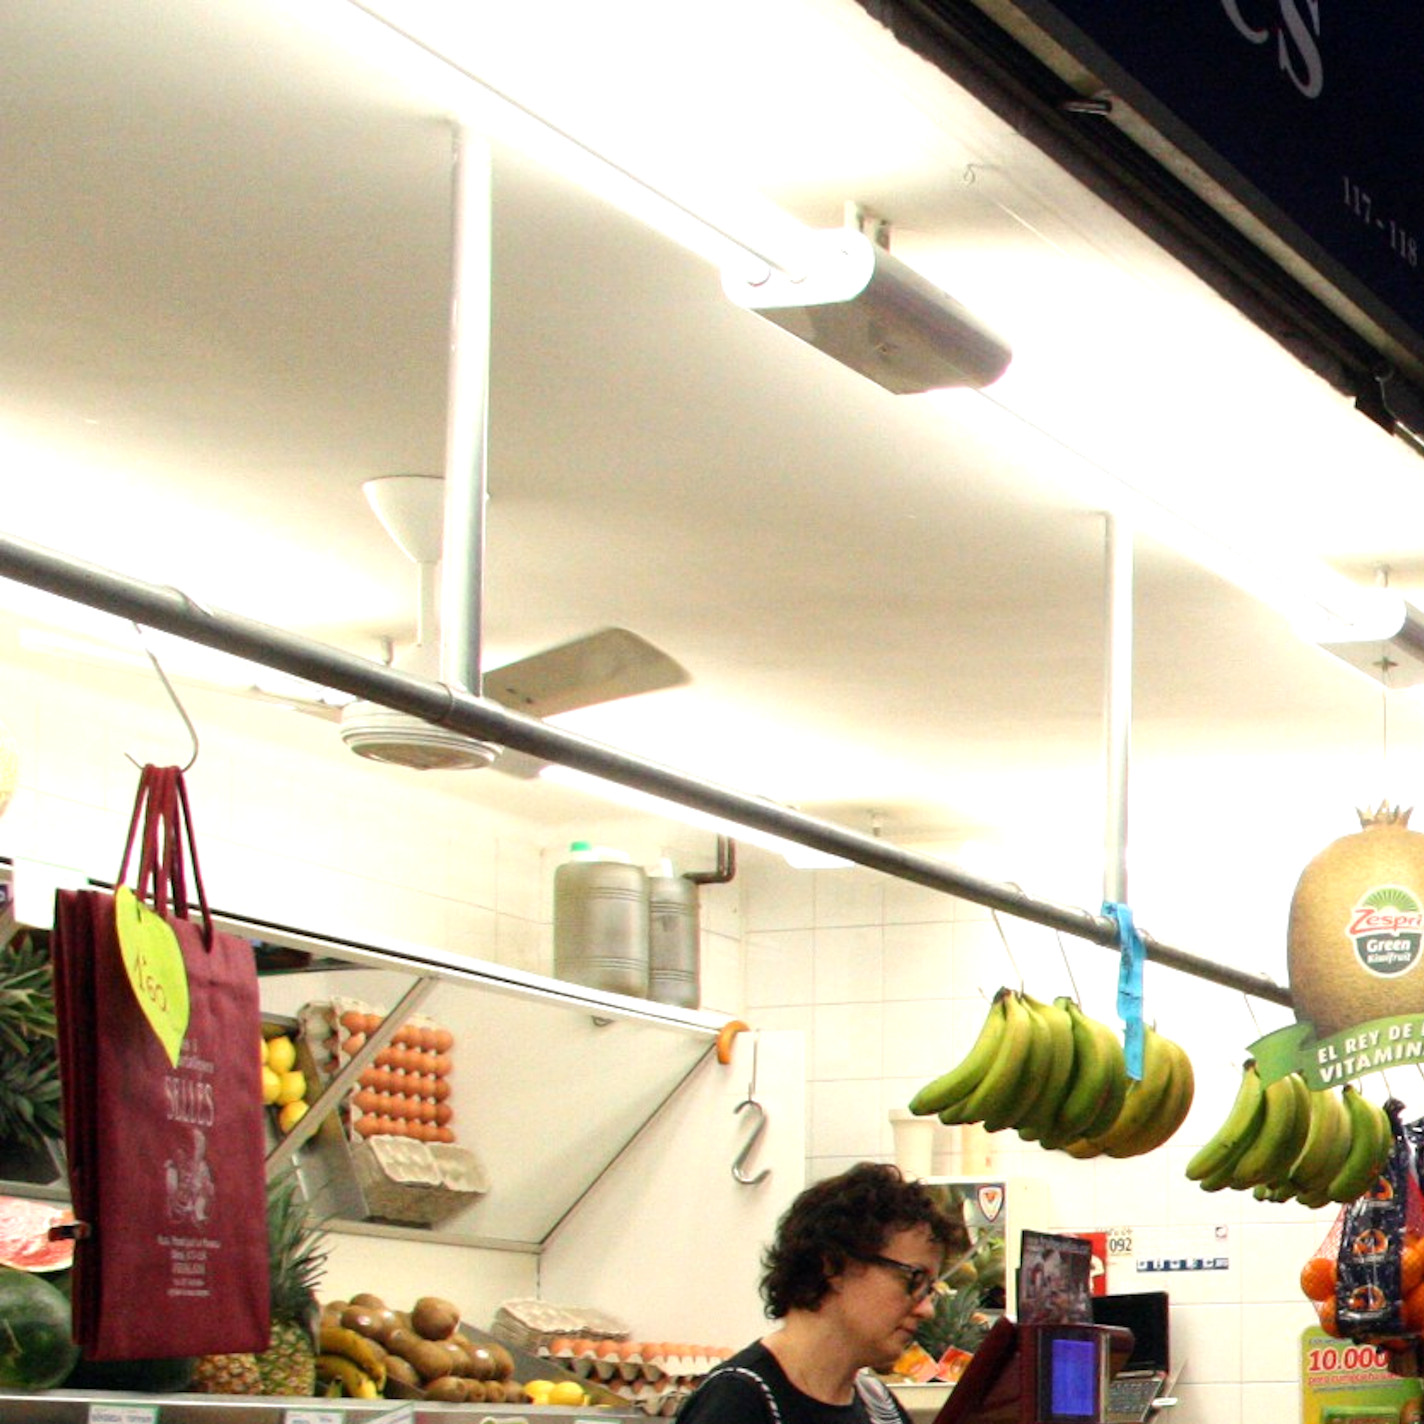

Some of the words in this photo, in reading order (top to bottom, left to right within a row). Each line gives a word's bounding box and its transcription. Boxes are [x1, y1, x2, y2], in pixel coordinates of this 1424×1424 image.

[1342, 175, 1420, 267] 117-118
[1348, 908, 1423, 936] Zespri
[1366, 939, 1411, 953] Green
[1317, 1045, 1338, 1065] EL
[1344, 1030, 1380, 1054] REY
[1388, 1022, 1413, 1041] DE
